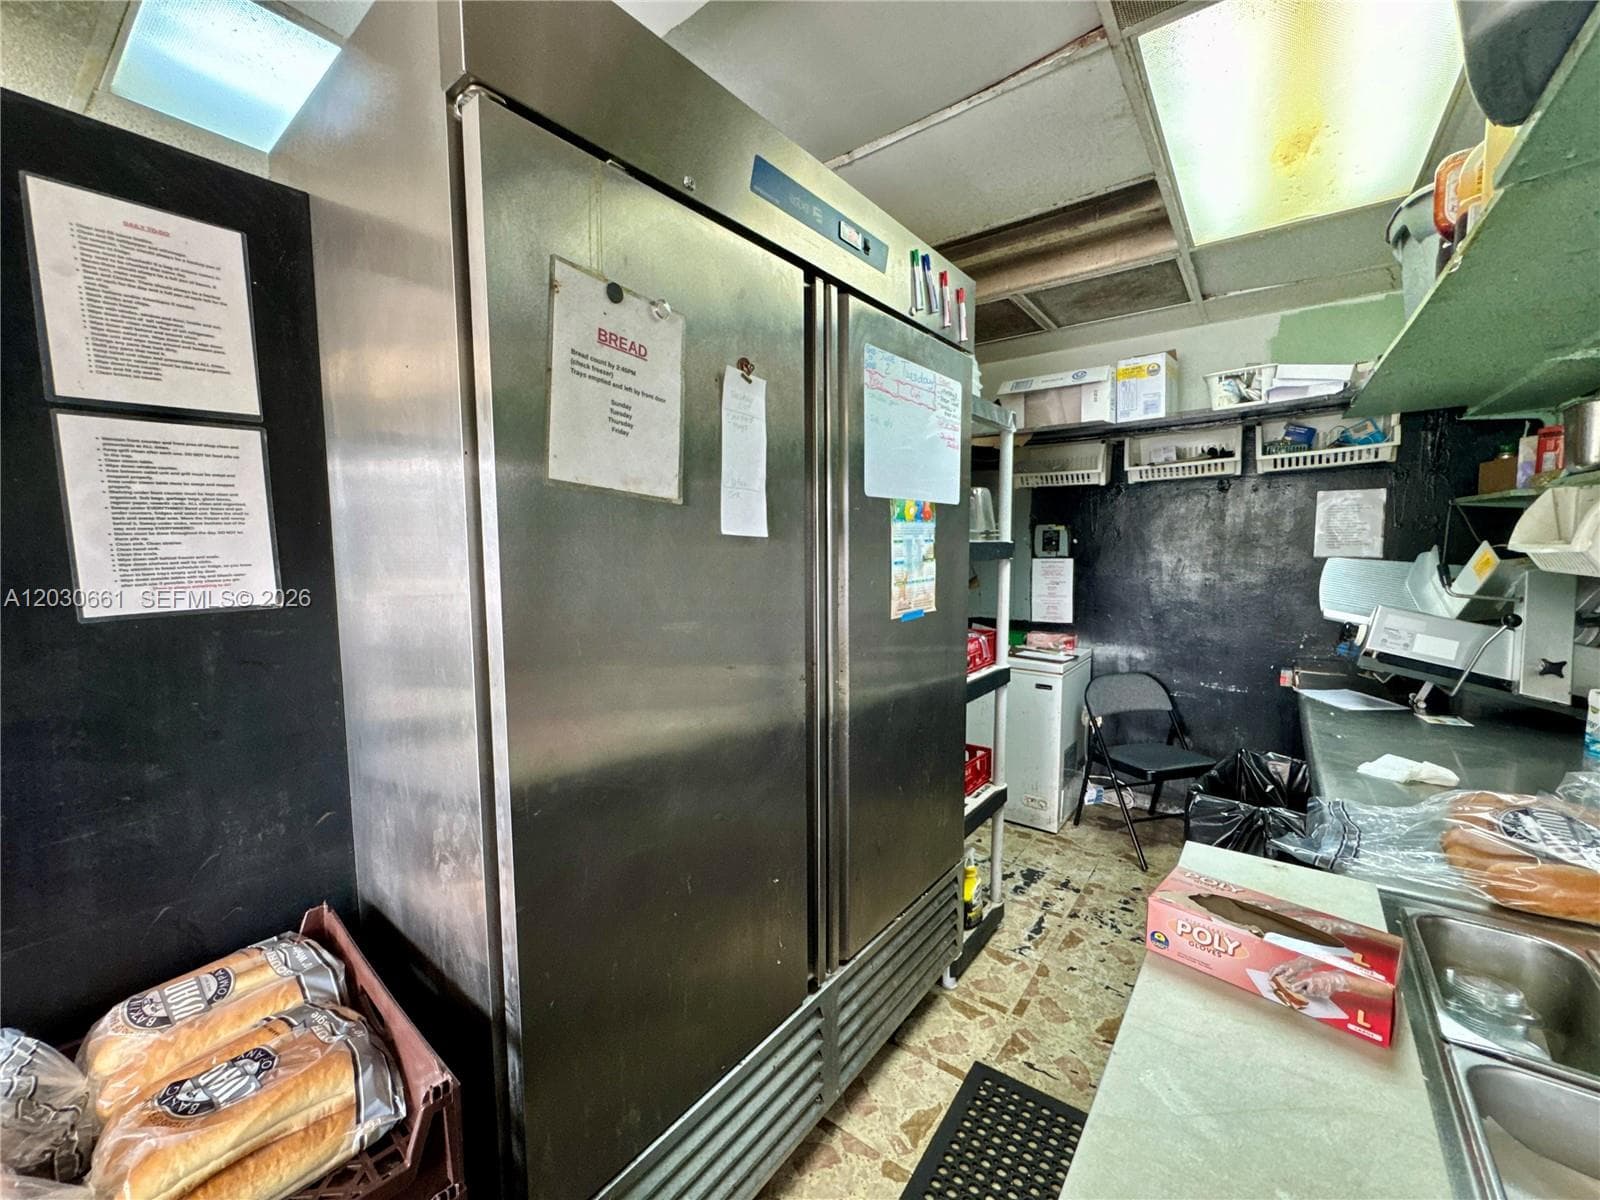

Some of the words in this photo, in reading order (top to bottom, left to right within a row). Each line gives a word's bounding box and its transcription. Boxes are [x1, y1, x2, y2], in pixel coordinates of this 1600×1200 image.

[597, 327, 648, 361] BREAD
[570, 357, 591, 370] (check
[592, 365, 614, 379] freezer)
[571, 348, 589, 360] Bread
[590, 355, 607, 367] count
[608, 360, 615, 370] by
[570, 367, 587, 379] Trays
[588, 374, 611, 386] emptied
[612, 382, 623, 390] and
[624, 384, 633, 393] left
[610, 407, 632, 421] Tuesday
[611, 399, 632, 411] Sunday
[608, 416, 634, 430] Thursday
[611, 426, 630, 437] Friday
[1176, 919, 1242, 958] POLY
[1188, 940, 1223, 958] GLOVES
[1357, 1009, 1372, 1029] L
